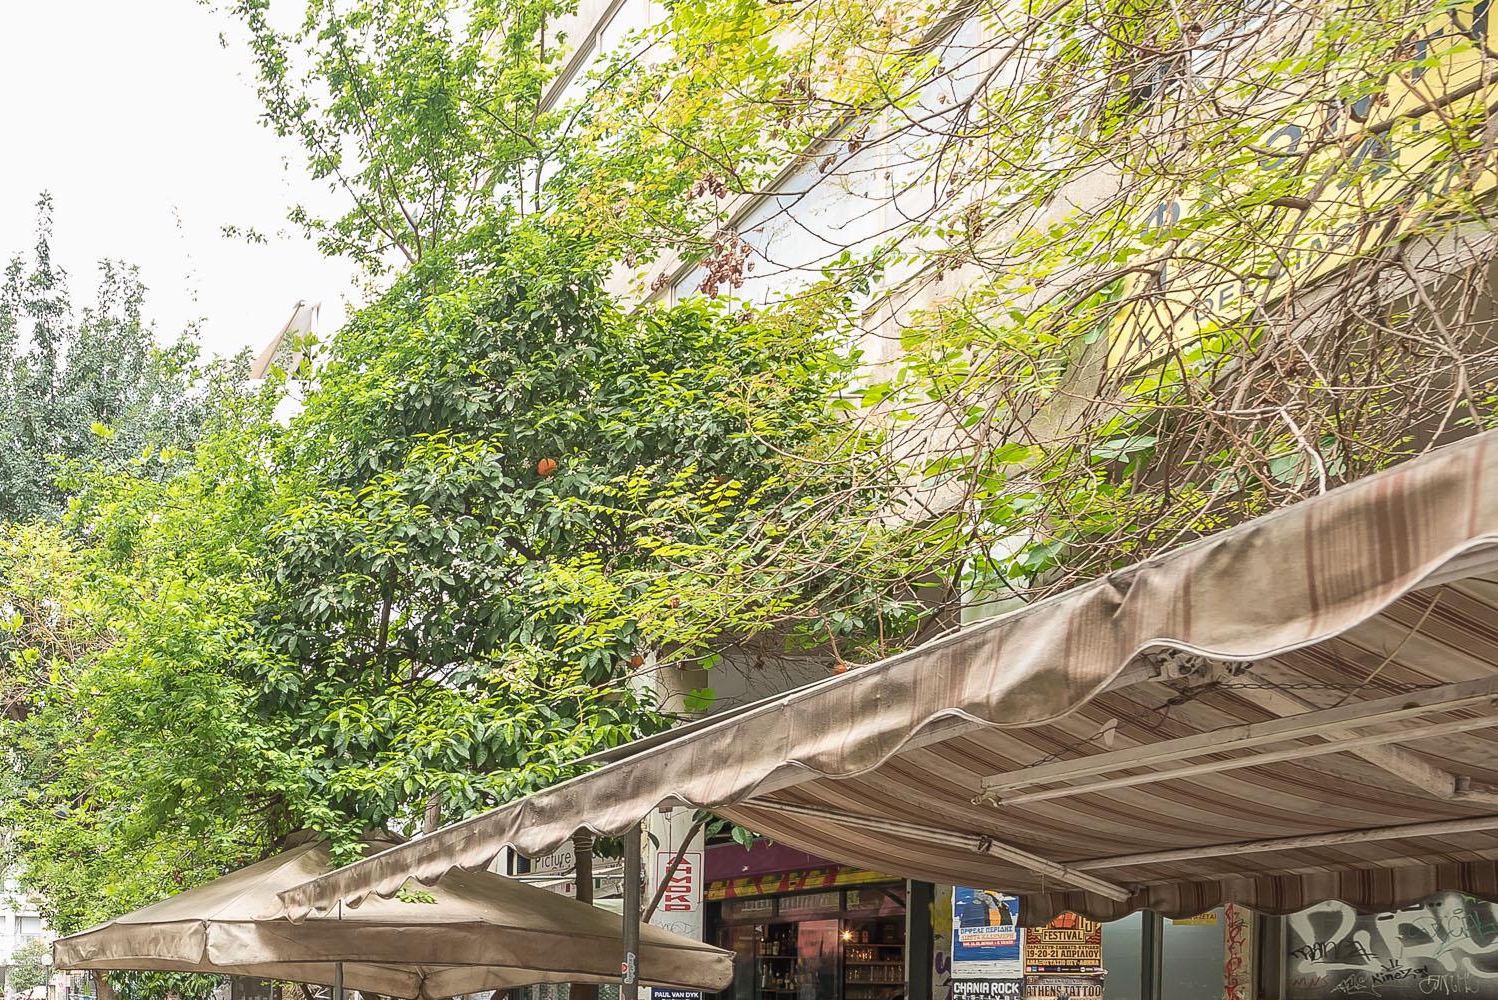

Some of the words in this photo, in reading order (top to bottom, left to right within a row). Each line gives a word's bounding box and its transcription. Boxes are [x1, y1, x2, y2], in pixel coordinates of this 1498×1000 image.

[534, 852, 572, 873] Picture
[1043, 930, 1083, 940] FESTIVAL
[953, 982, 989, 995] CHANIA
[991, 982, 1020, 996] ROCK
[1026, 985, 1062, 997] ATHENS
[1064, 985, 1101, 997] TATTOO
